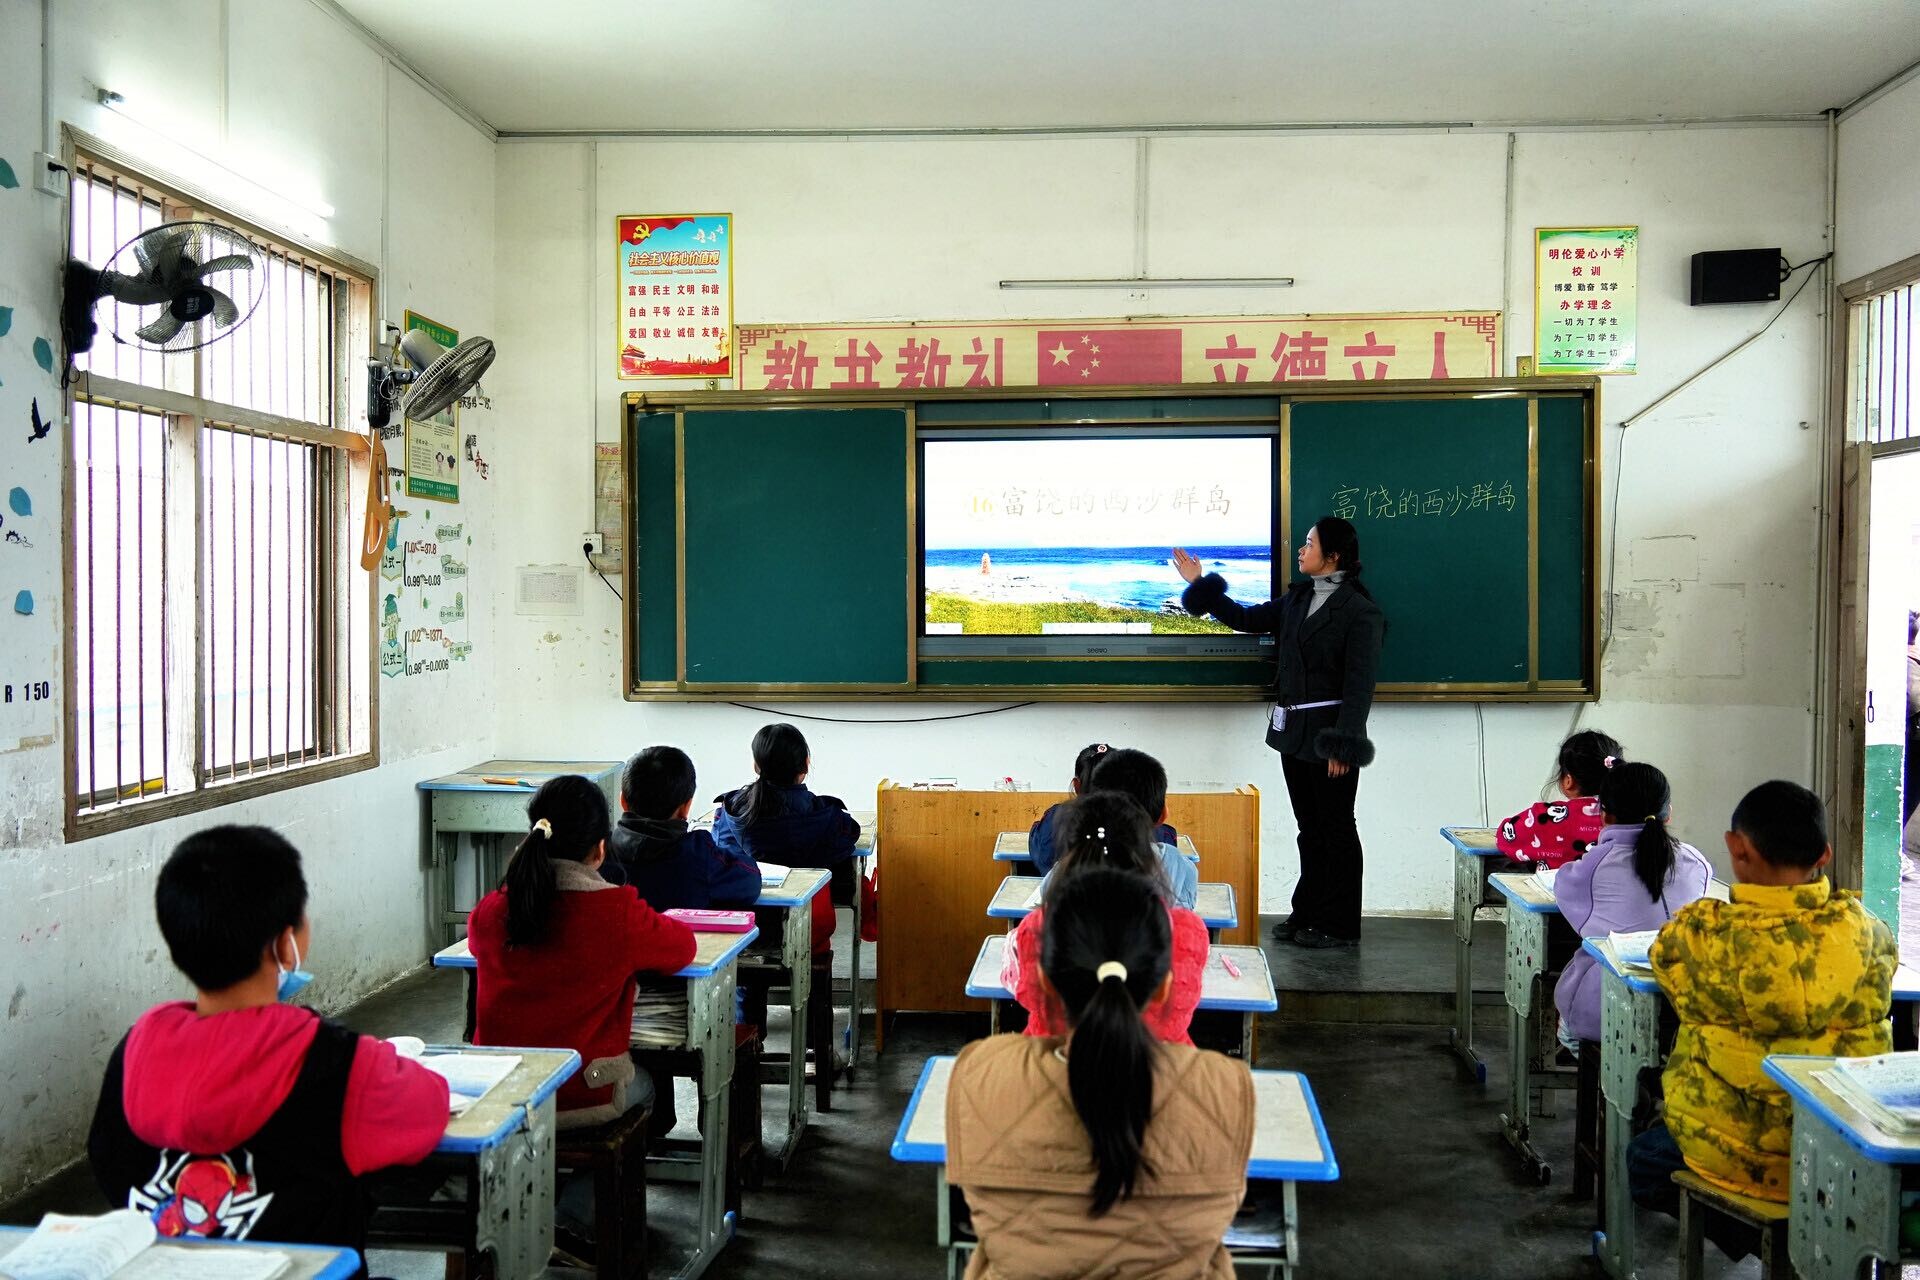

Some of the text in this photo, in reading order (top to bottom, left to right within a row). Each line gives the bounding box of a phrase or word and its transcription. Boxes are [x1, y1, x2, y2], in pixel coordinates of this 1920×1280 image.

[628, 250, 720, 267] 社会主义核心价值观
[1548, 247, 1625, 260] 明伦爱心小学
[1572, 266, 1602, 276] 校训
[628, 284, 720, 296] 富强 民主 文明 和谐
[1554, 282, 1619, 292] 博爱 勤奋 笃学
[629, 305, 720, 318] 自由 平等 公正 法治
[1560, 300, 1612, 311] 办学理念
[1553, 317, 1619, 327] 一切为了学生
[628, 326, 720, 339] 爱国 敬业 诚信 友善
[1553, 333, 1619, 343] 为了一切学生
[1553, 349, 1618, 359] 为了学生一切
[1001, 483, 1231, 517] 富饶的西沙群岛
[1330, 479, 1516, 520] 富饶的西沙群岛
[383, 653, 402, 666] 公式二
[24, 681, 50, 701] 150
